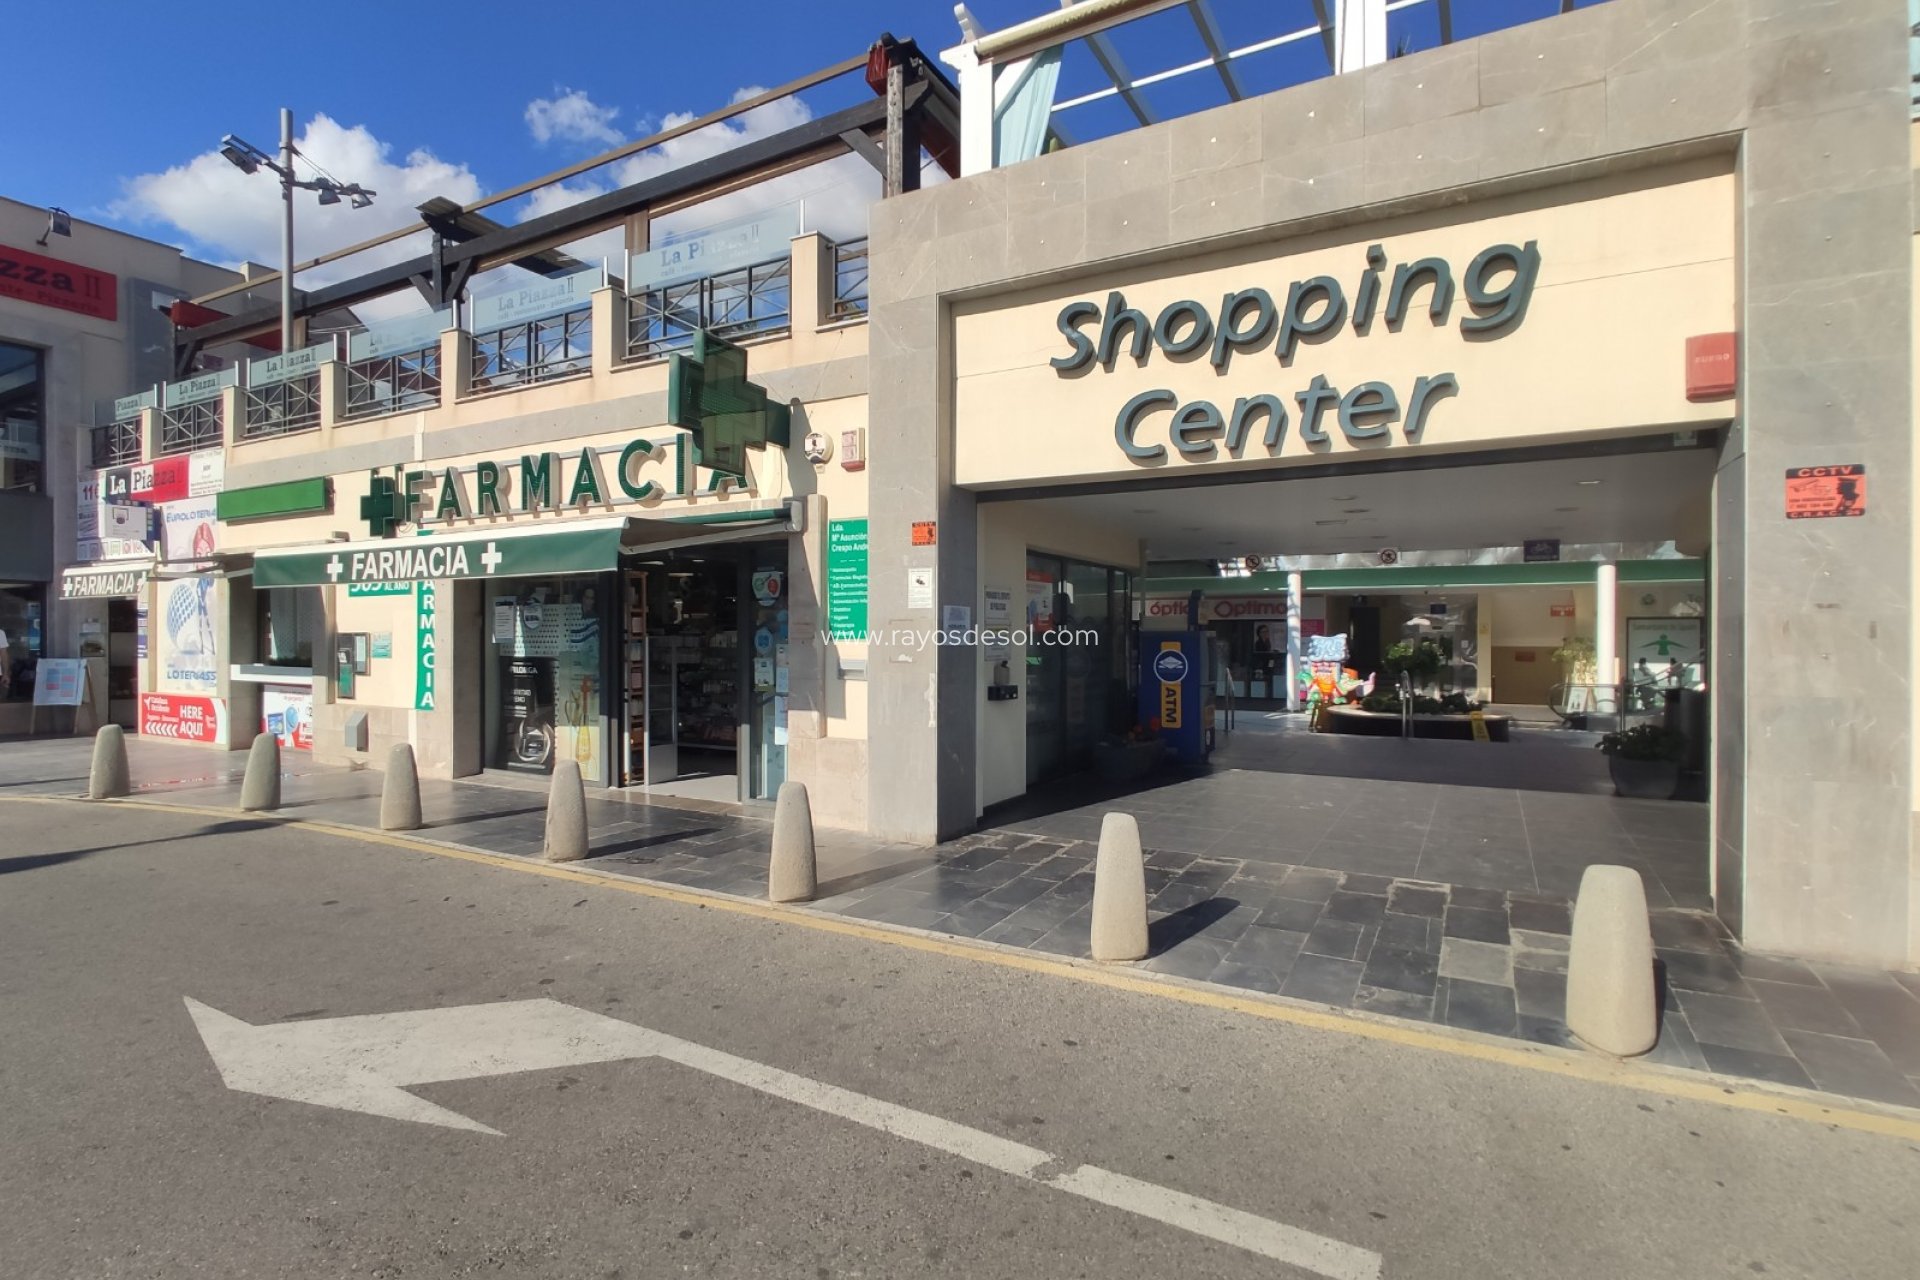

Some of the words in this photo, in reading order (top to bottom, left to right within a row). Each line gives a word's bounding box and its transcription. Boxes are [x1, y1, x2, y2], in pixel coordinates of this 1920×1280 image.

[661, 250, 681, 267] La
[498, 295, 514, 312] La
[519, 284, 565, 306] Piazza
[1049, 238, 1540, 371] Shopping
[1114, 371, 1458, 459] Center
[110, 474, 127, 496] La
[133, 469, 176, 491] Piazza
[1797, 465, 1853, 477] CCTV
[352, 545, 470, 580] FARMACIA
[72, 572, 135, 597] FARMACIA
[420, 579, 435, 708] ARMACIA
[179, 705, 204, 721] HERE
[1163, 686, 1178, 724] ATM
[179, 720, 204, 738] AQUI
